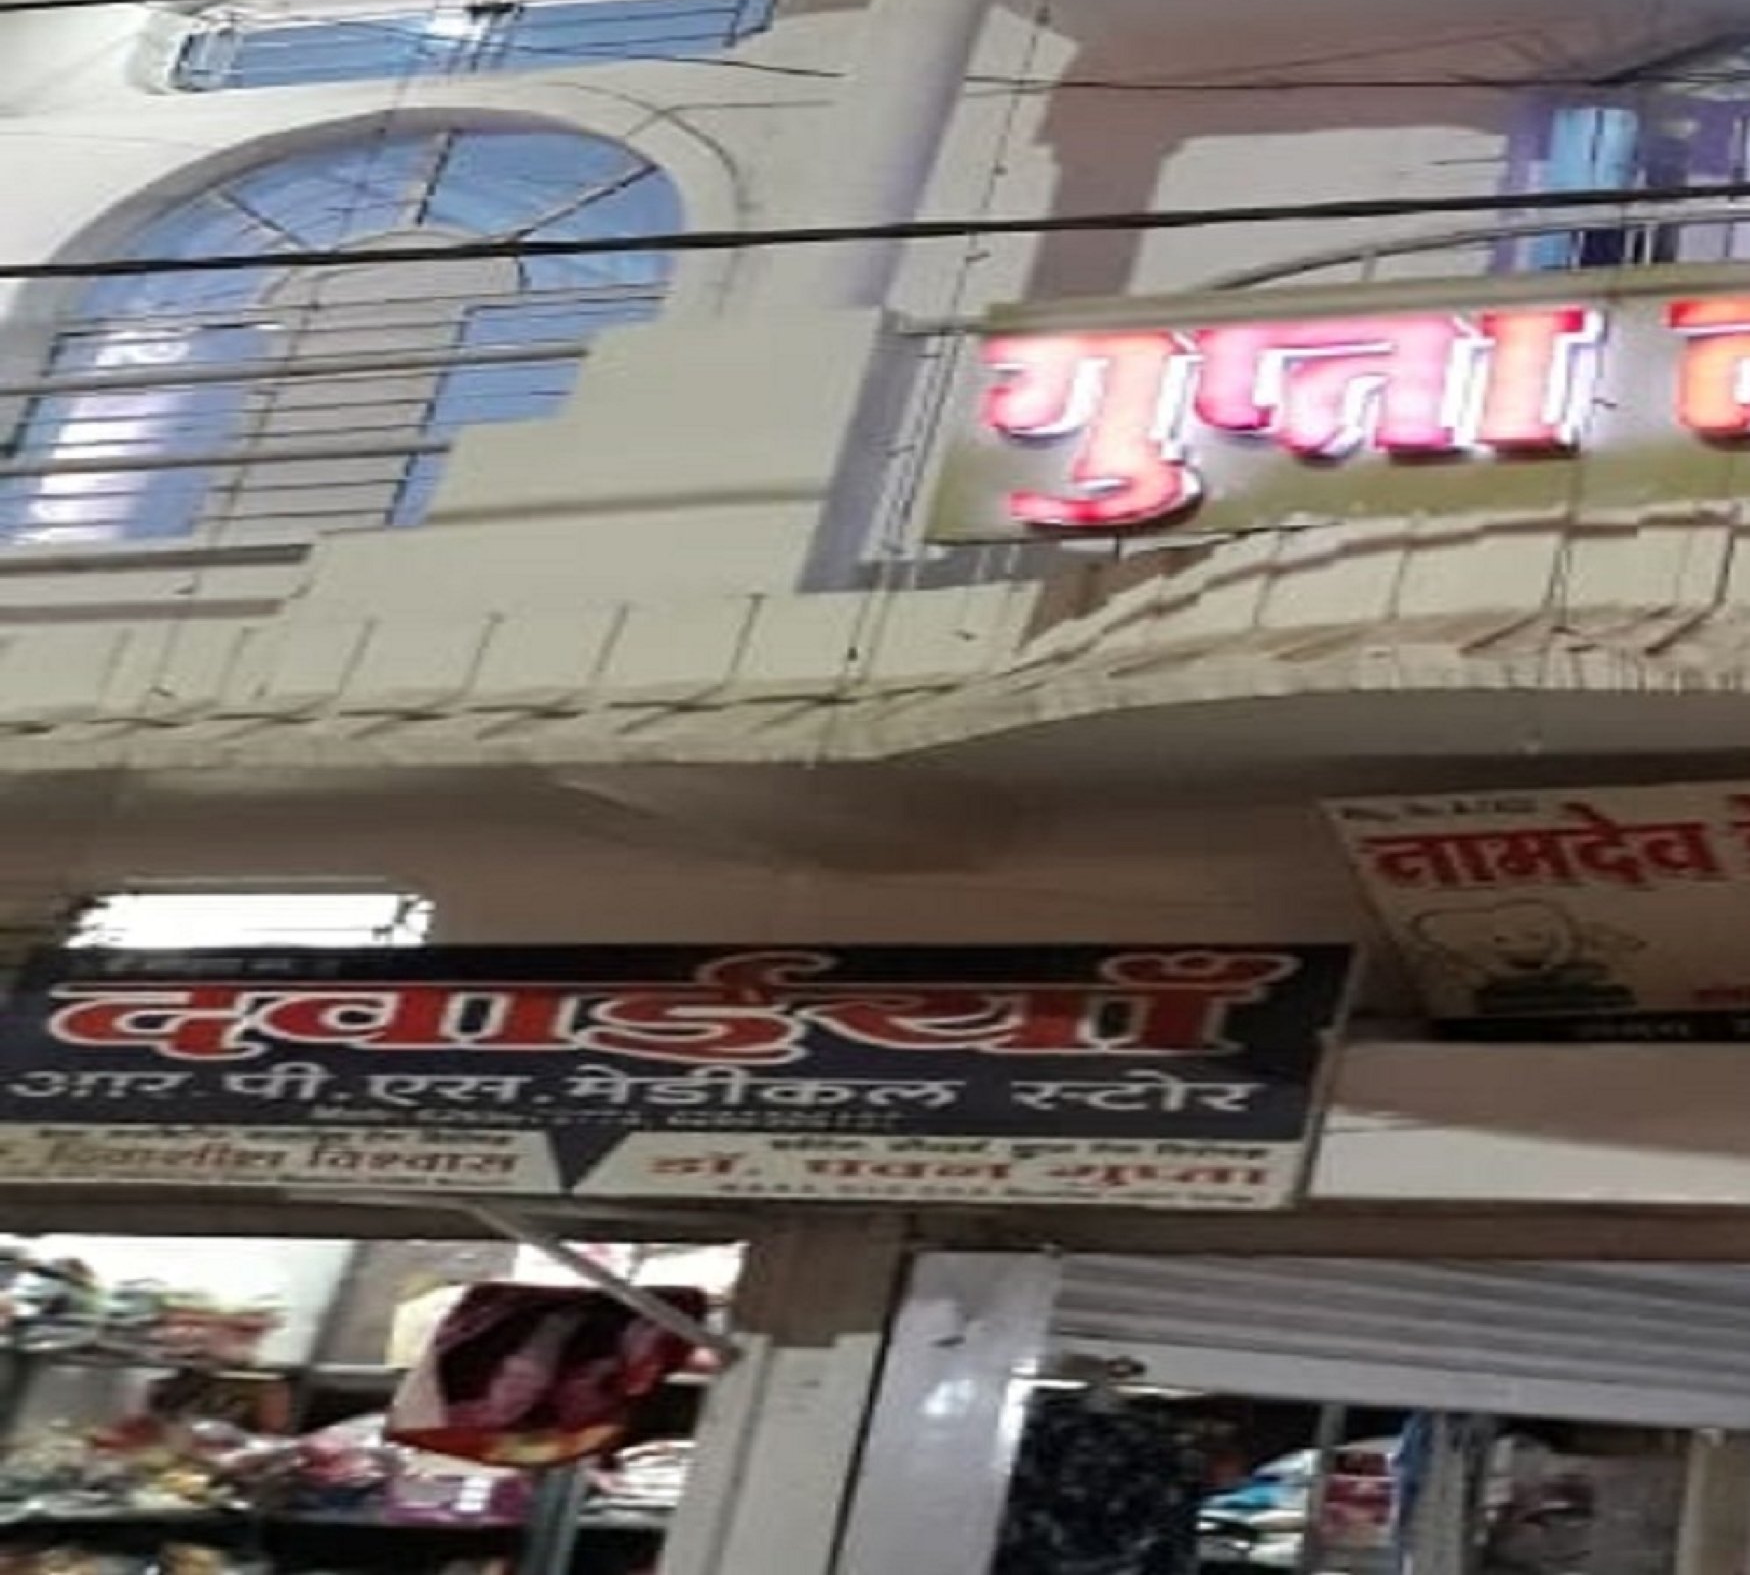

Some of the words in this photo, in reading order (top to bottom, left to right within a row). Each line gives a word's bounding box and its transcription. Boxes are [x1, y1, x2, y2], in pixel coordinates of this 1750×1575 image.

[980, 305, 1604, 529] गुप्ता
[1360, 802, 1722, 889] नामदेव
[1008, 1069, 1270, 1113] स्टोर
